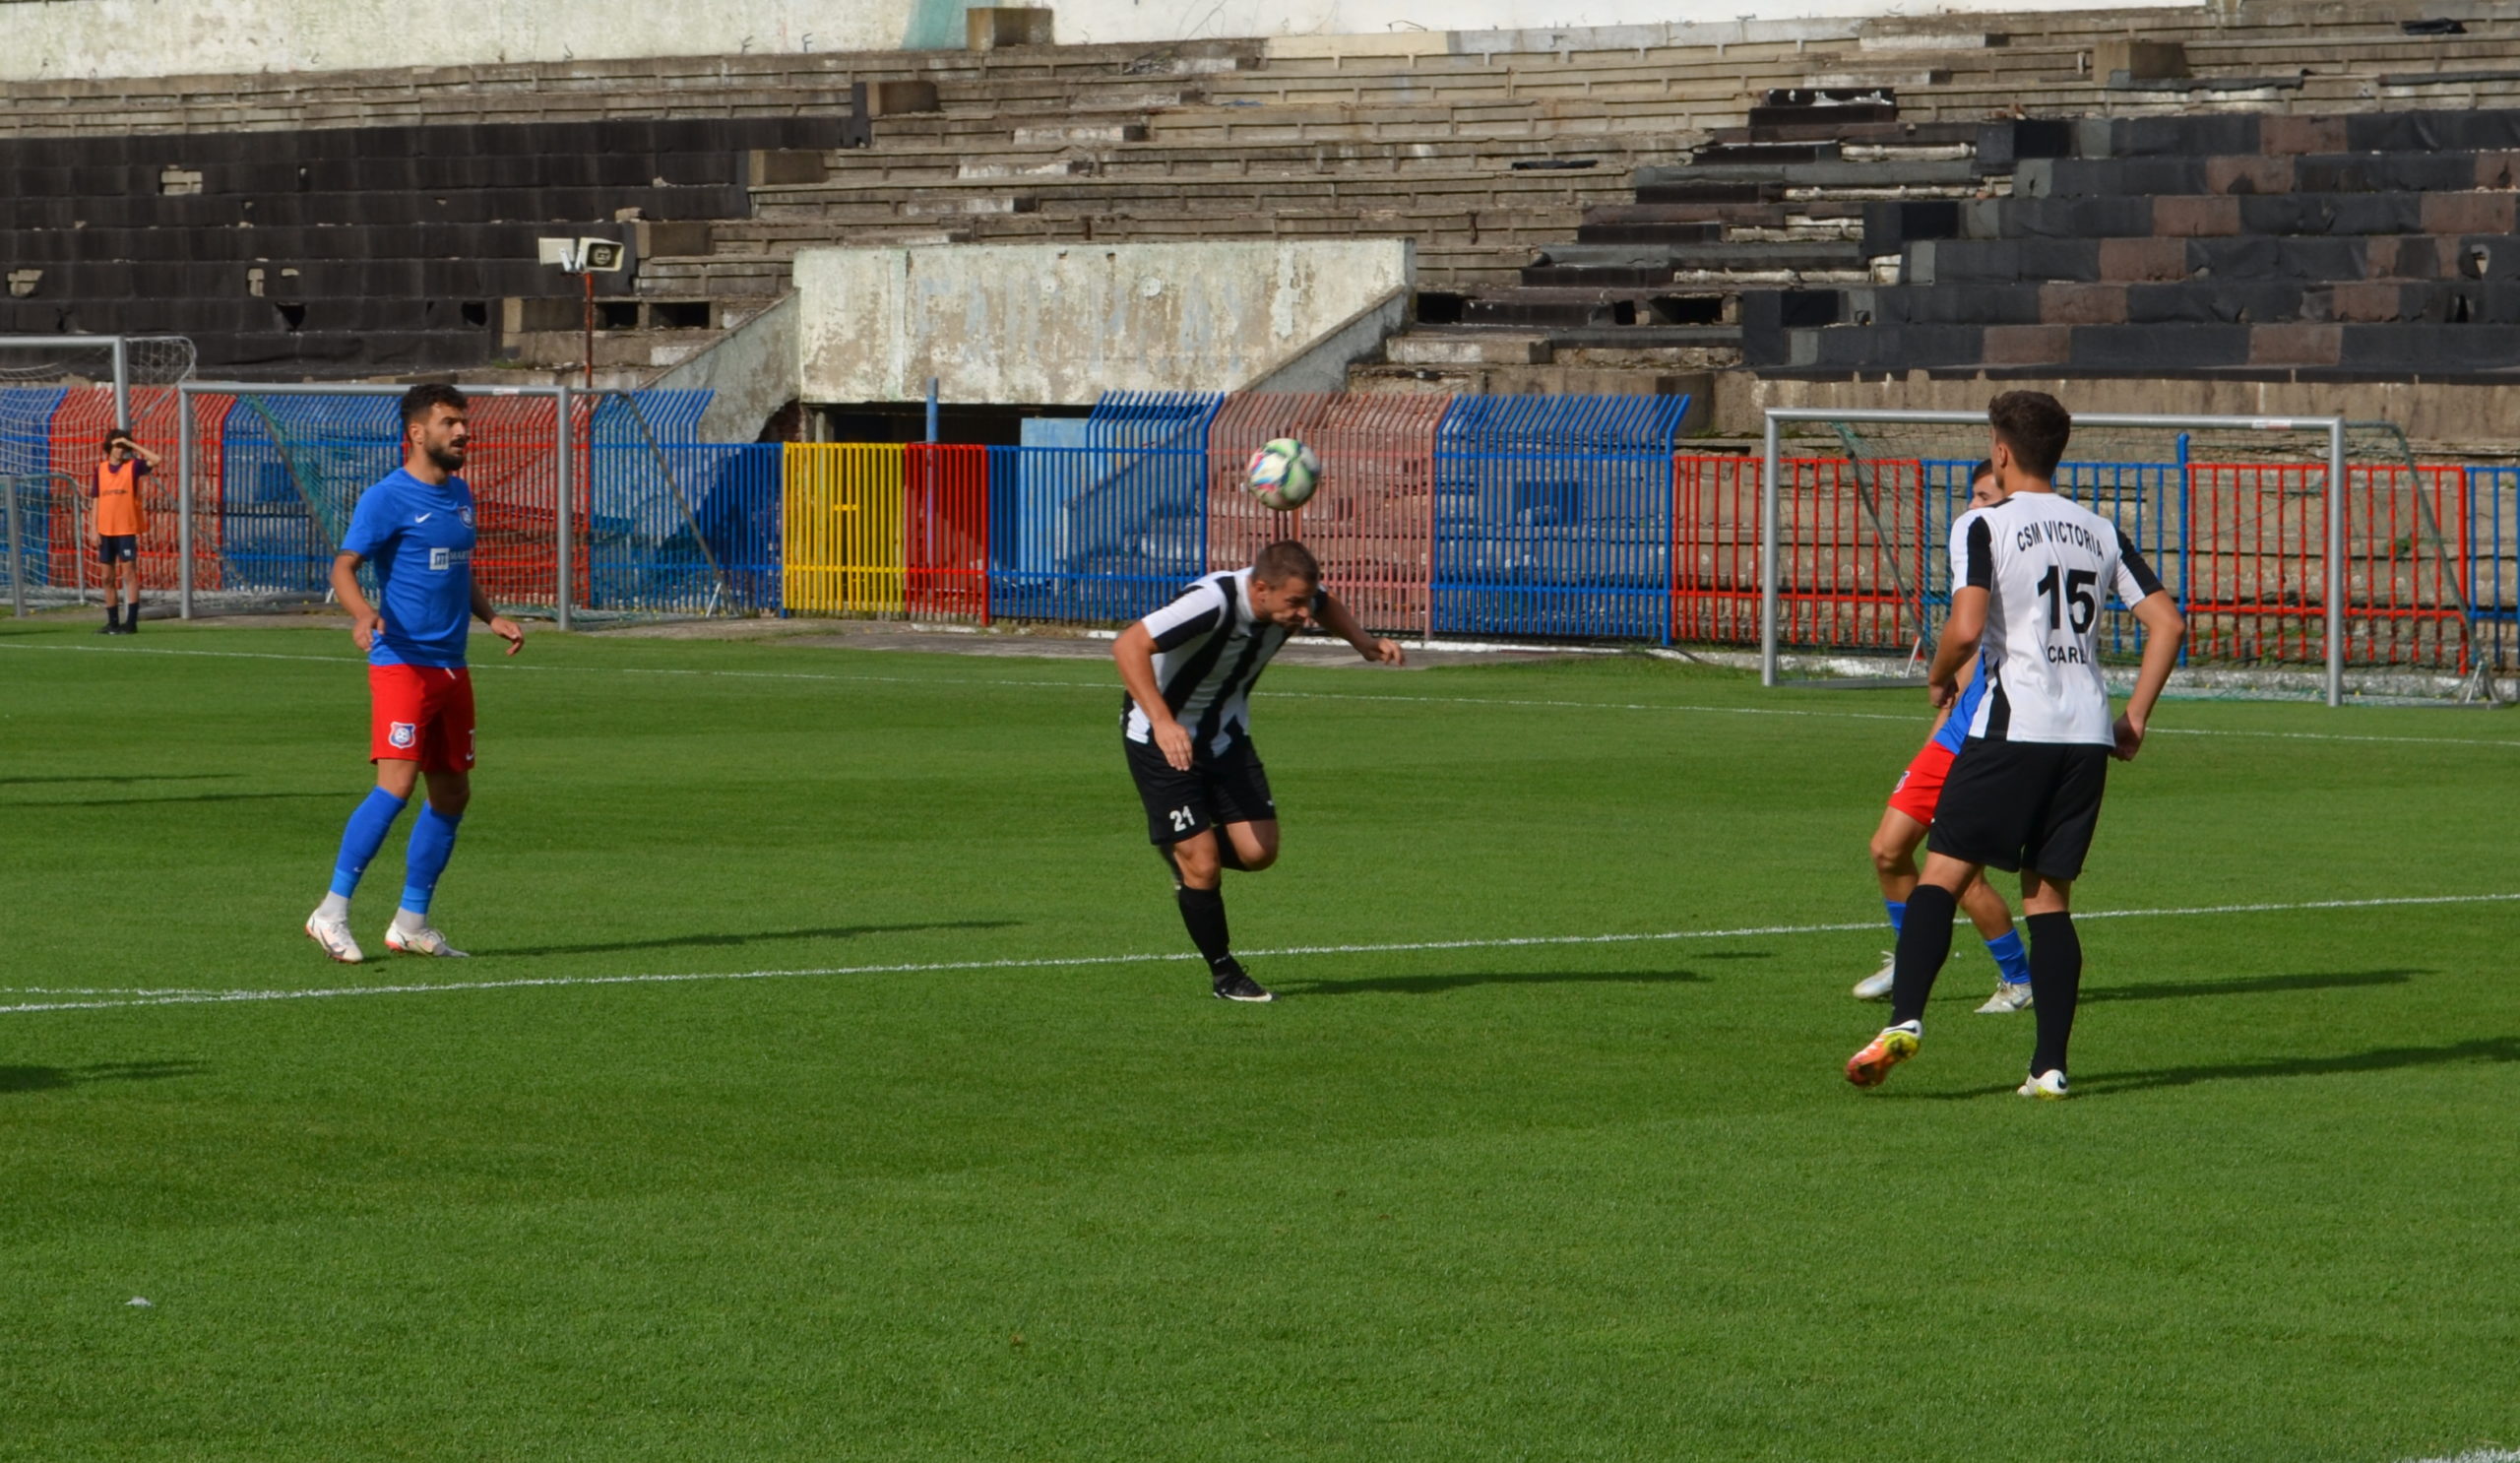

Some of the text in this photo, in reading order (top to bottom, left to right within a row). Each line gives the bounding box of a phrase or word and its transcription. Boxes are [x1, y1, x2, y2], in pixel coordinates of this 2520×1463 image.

[2017, 520, 2105, 561] CSM VICTORIA
[2037, 565, 2098, 634] 15
[1169, 805, 1195, 832] 21
